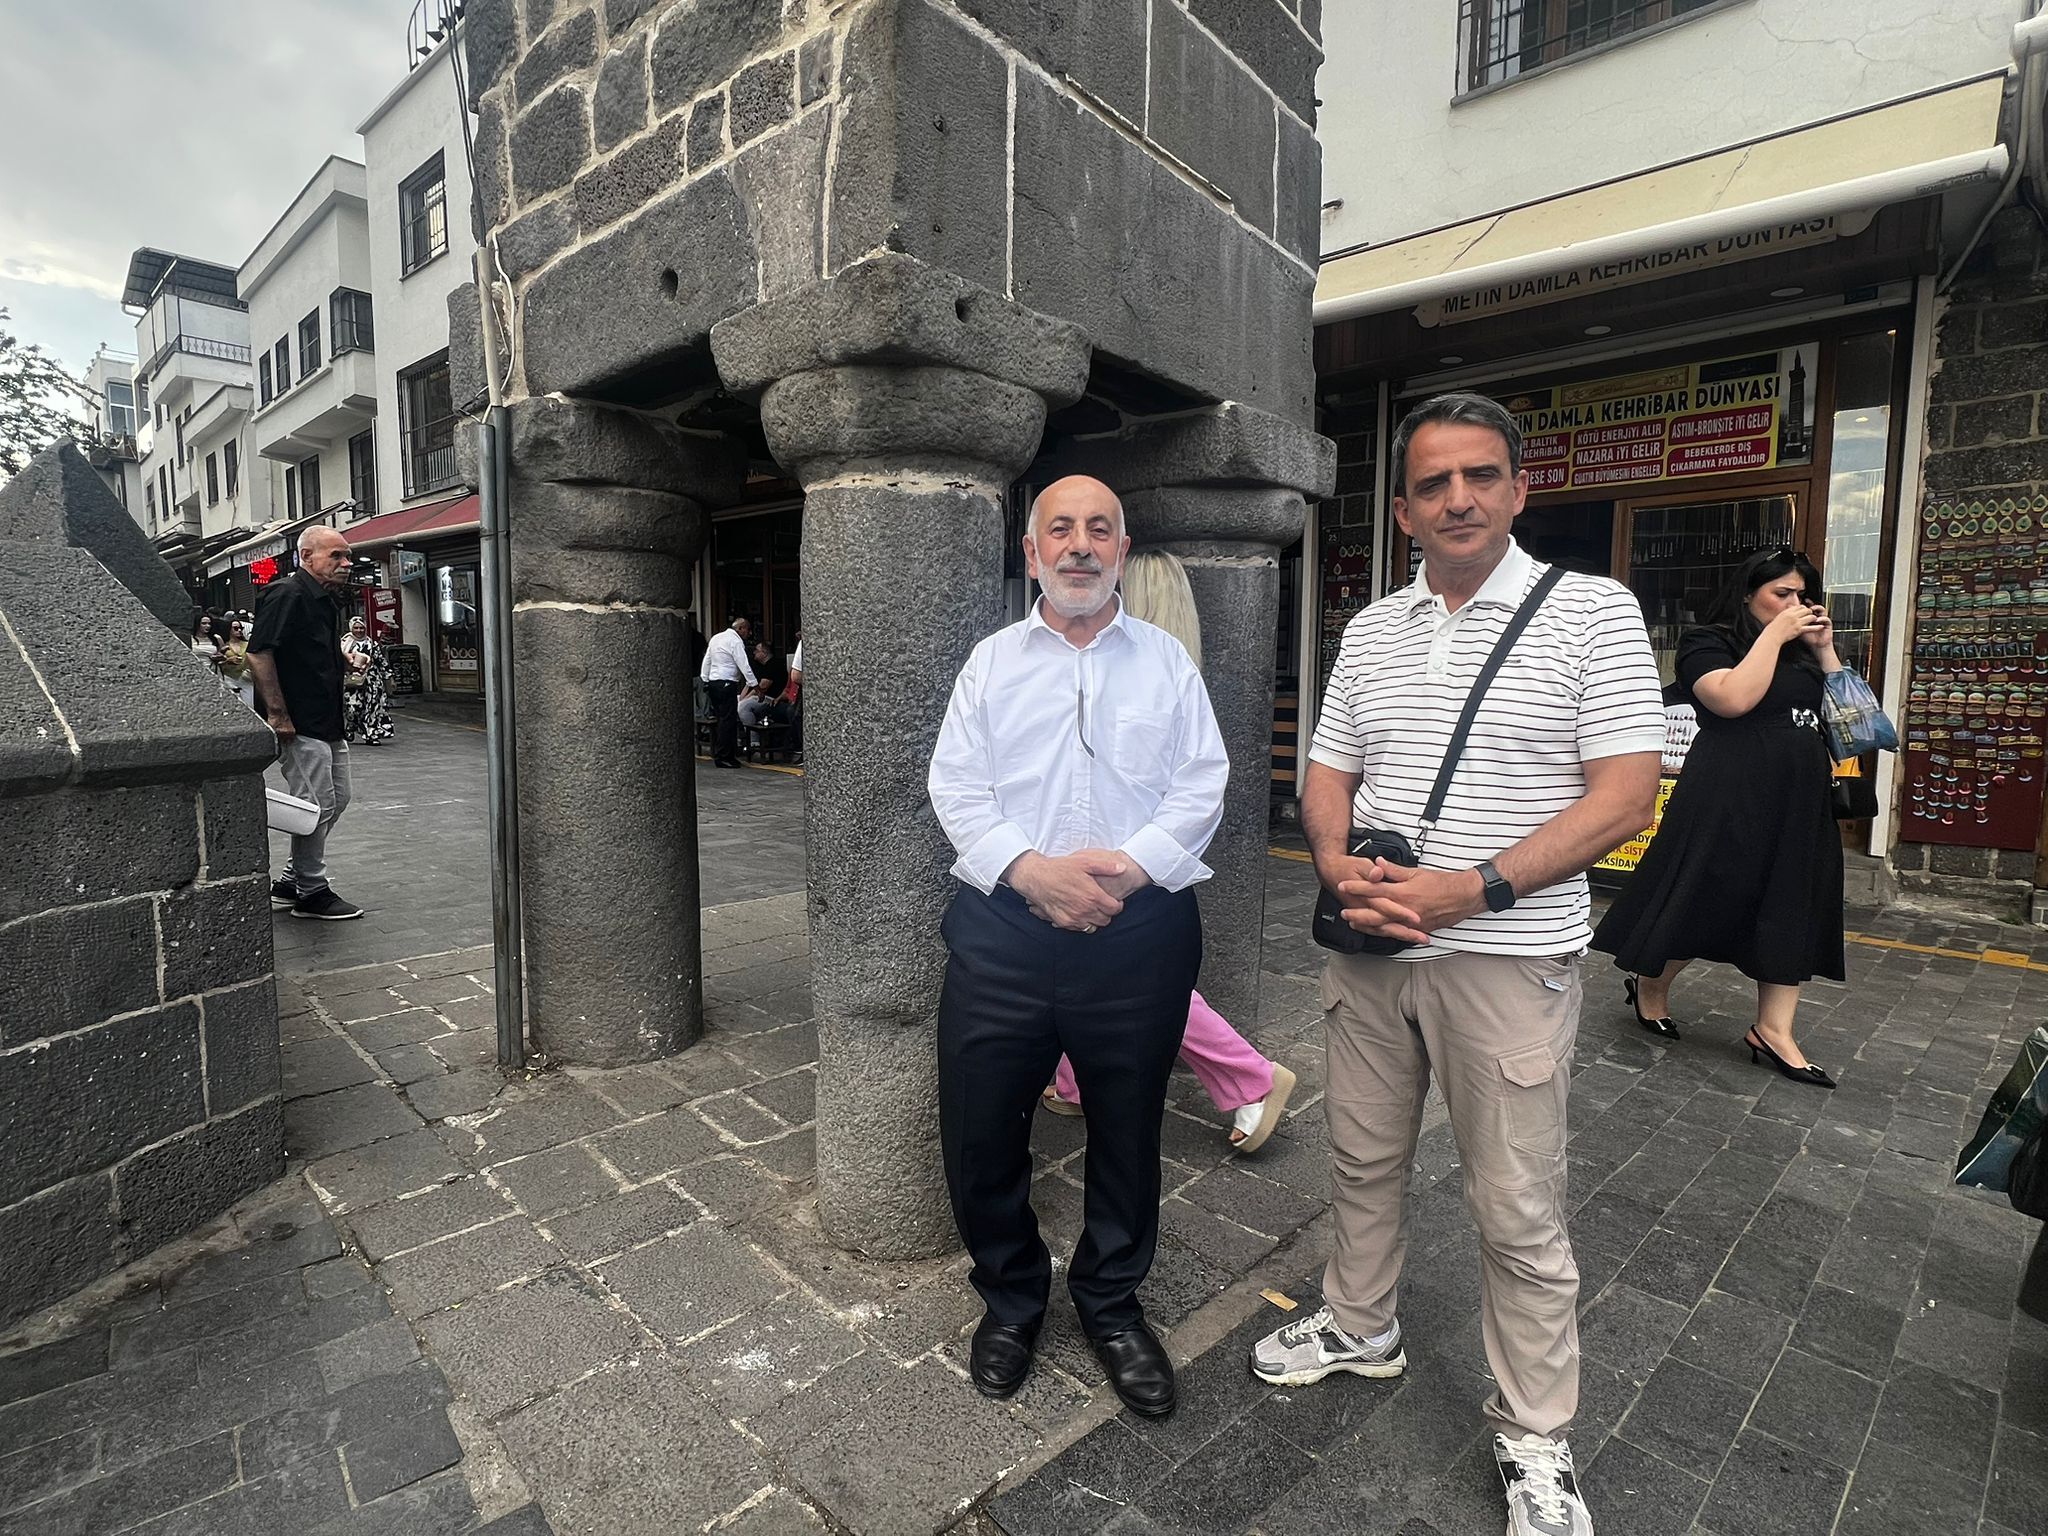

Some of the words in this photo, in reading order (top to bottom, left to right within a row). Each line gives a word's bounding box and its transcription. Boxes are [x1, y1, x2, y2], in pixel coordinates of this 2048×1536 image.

[1508, 270, 1581, 301] DAMLA
[1537, 403, 1595, 431] DAMLA
[1695, 375, 1780, 409] DÜNYASI
[1641, 423, 1662, 438] ALIR
[1576, 447, 1614, 465] NAZARA
[1684, 443, 1736, 458] BEBEKLERDE
[1670, 458, 1717, 475] ÇIKARMAYA
[1717, 452, 1766, 468] FAYDALIDIR
[1527, 470, 1545, 485] ESE
[1548, 468, 1565, 484] SON
